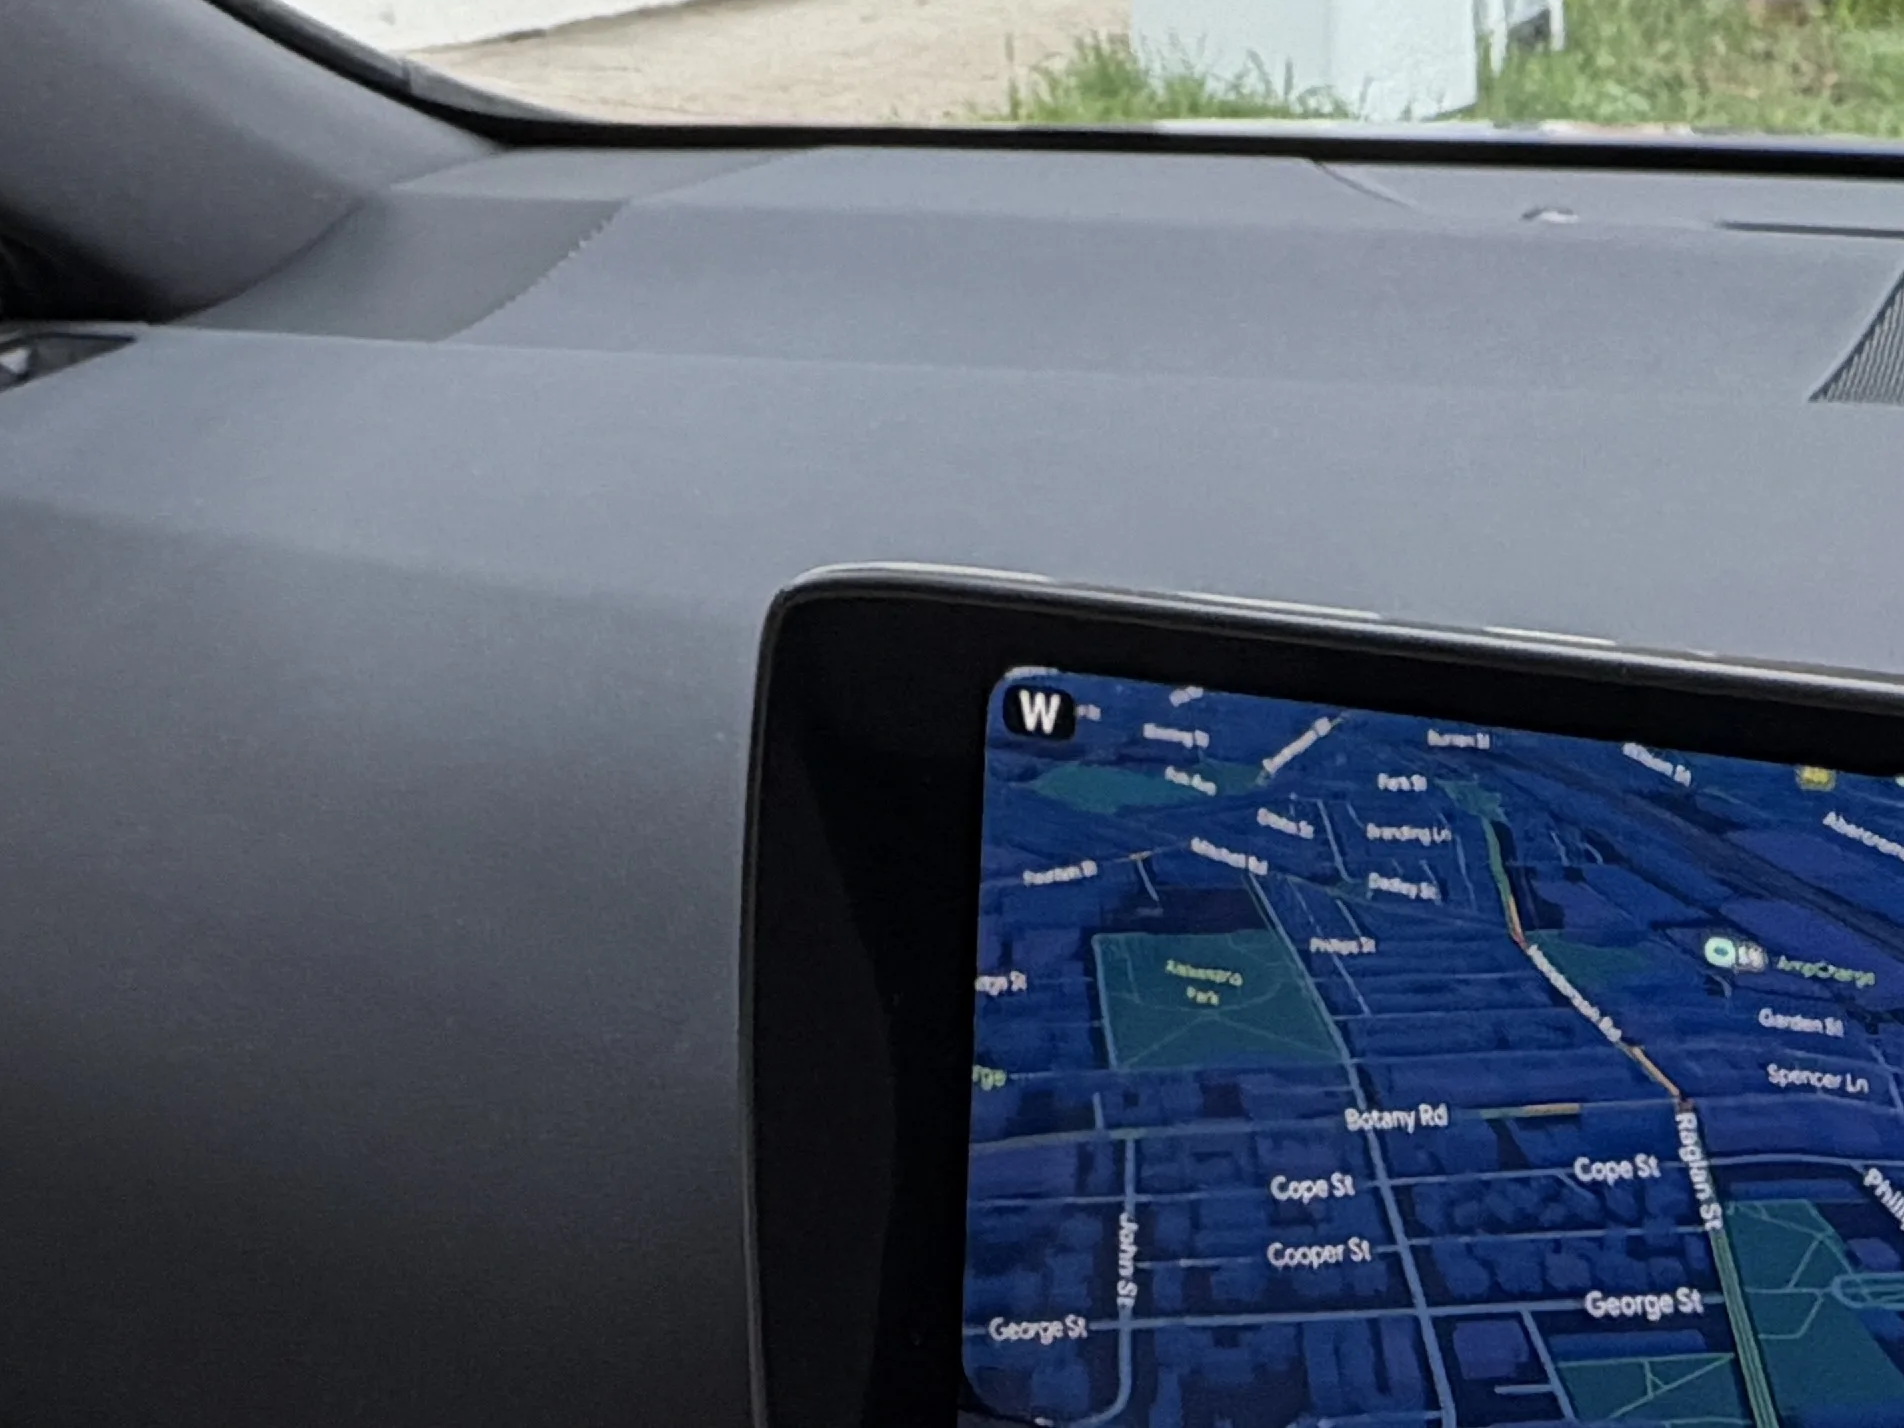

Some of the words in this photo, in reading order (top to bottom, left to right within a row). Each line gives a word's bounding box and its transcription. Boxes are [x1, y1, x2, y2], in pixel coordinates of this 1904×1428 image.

[1019, 689, 1061, 735] W
[1344, 1108, 1415, 1134] Botany
[1418, 1103, 1449, 1127] Rd
[1573, 1156, 1633, 1187] Cope
[1634, 1153, 1661, 1179] St
[1270, 1175, 1329, 1204] Cope
[1330, 1171, 1356, 1197] St
[1699, 1202, 1724, 1231] St
[1118, 1212, 1139, 1278] John
[1266, 1242, 1345, 1269] Cooper
[1347, 1236, 1372, 1263] St
[1116, 1279, 1138, 1307] St
[1584, 1290, 1674, 1321] George
[1675, 1286, 1704, 1314] St
[988, 1316, 1064, 1345] George
[1064, 1313, 1088, 1339] St
